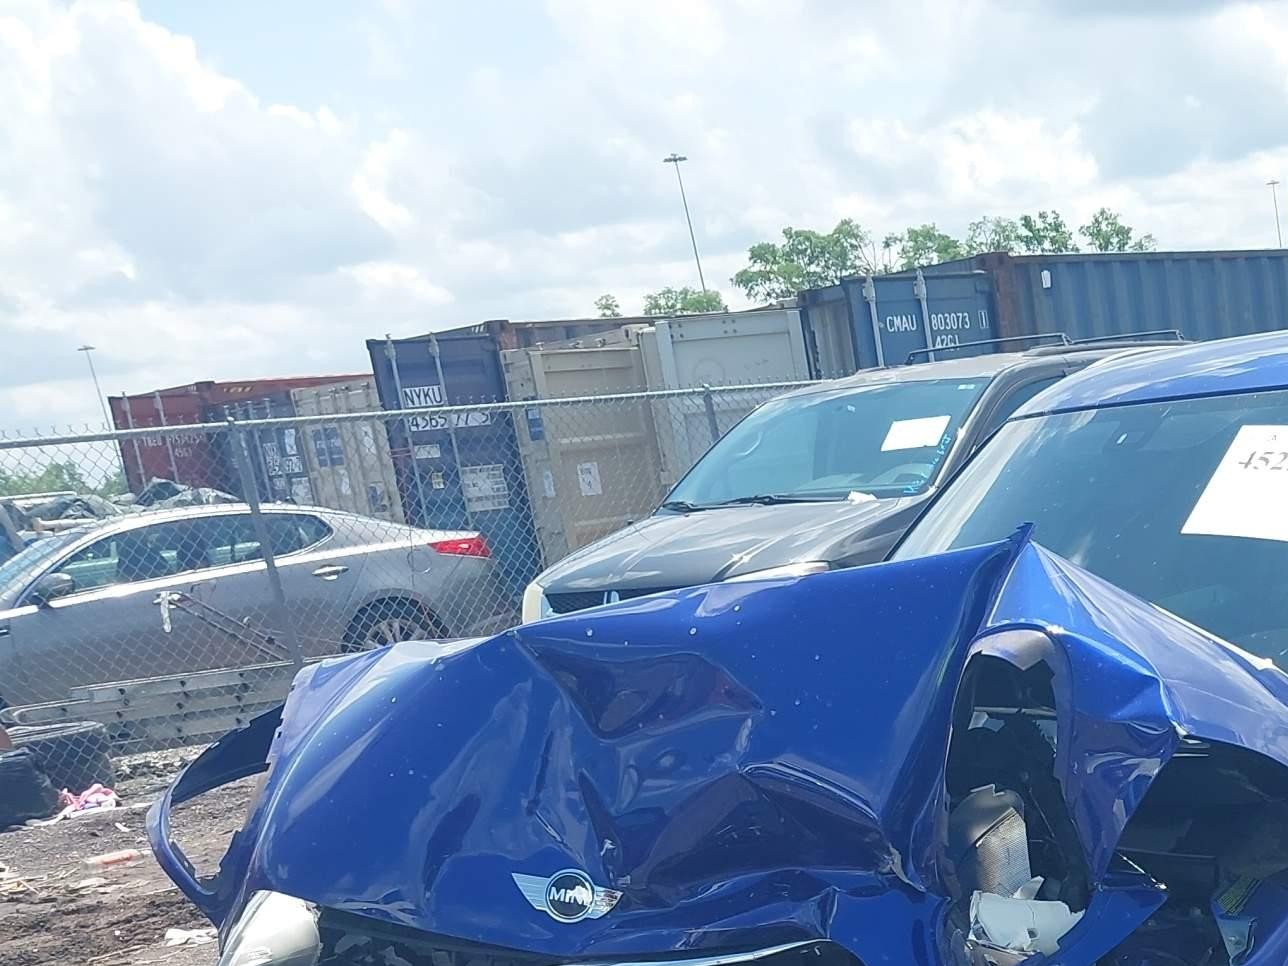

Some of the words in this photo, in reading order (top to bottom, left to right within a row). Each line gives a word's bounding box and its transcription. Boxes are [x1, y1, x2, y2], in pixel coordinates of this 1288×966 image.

[886, 315, 917, 332] CMAU
[931, 312, 970, 330] 803073
[403, 386, 443, 407] NYKU
